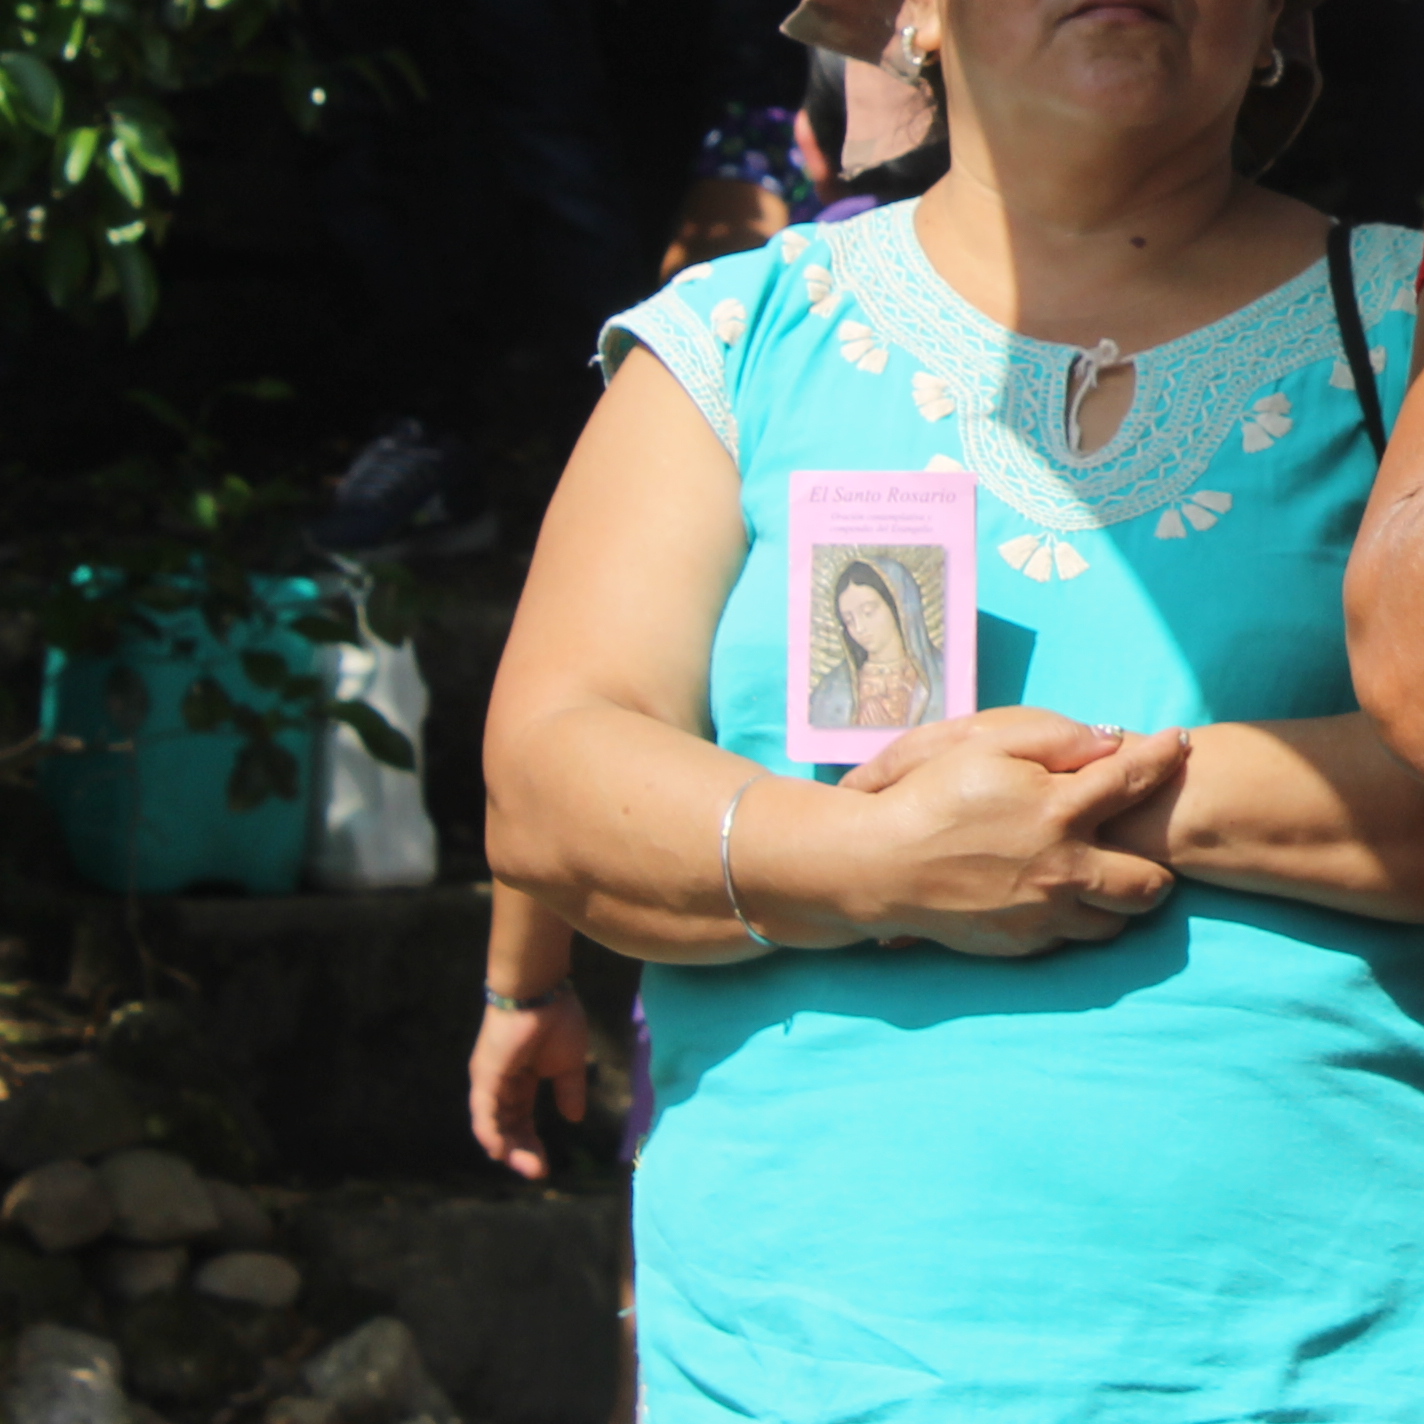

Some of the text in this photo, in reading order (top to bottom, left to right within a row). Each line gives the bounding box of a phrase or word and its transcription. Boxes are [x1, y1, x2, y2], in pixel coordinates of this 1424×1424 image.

[808, 485, 957, 504] El Santo Rosario
